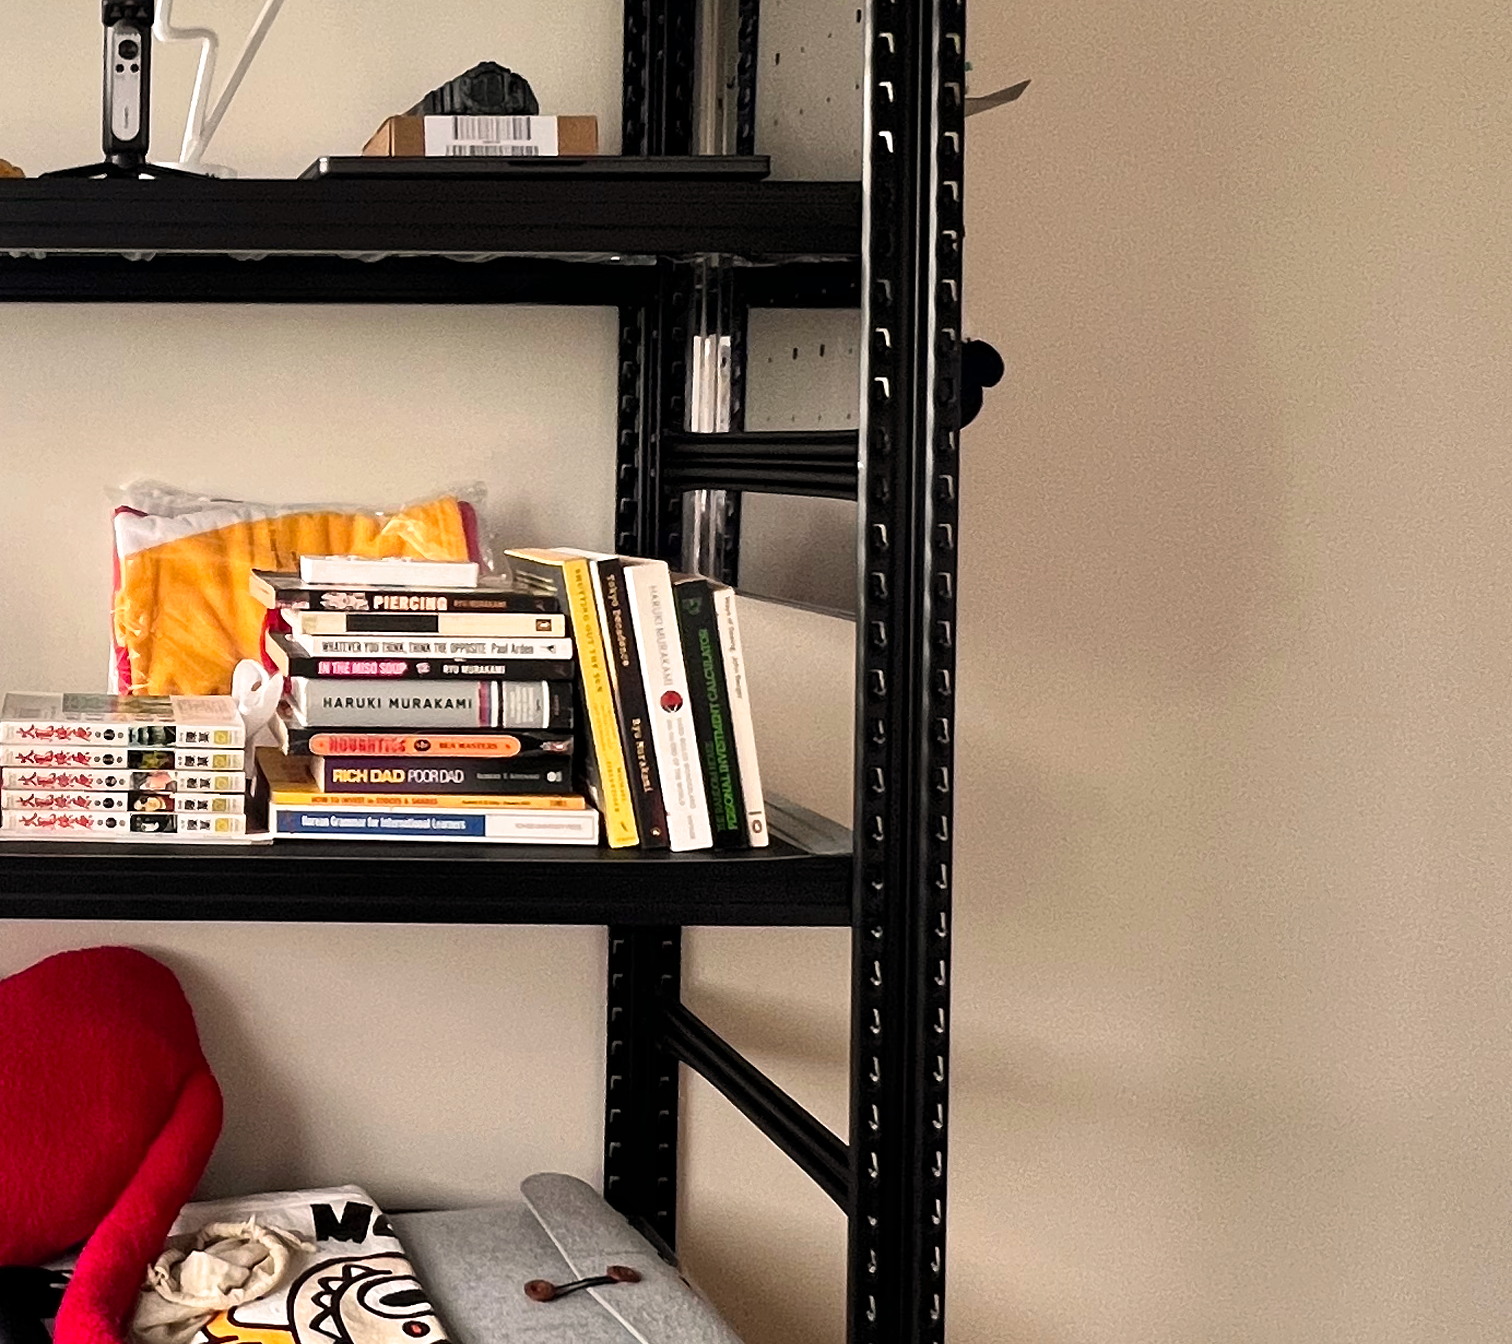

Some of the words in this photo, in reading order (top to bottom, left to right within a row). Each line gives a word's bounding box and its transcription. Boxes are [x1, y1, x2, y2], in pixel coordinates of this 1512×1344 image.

[373, 596, 448, 611] PIERCING
[606, 574, 620, 607] Tokyo
[648, 585, 664, 626] HARUKI
[322, 642, 362, 653] WHATEVER
[364, 642, 380, 653] YOU
[433, 643, 448, 654] THE
[450, 643, 487, 654] OPPOSITE
[491, 643, 508, 654] Paul
[510, 643, 535, 654] Arden
[585, 624, 595, 645] OUT
[612, 608, 630, 667] Decadence
[461, 665, 506, 674] MURAKAMI
[655, 627, 674, 687] MURAKAMI
[698, 628, 719, 702] CALCULATOR
[322, 697, 382, 709] HARUKI
[388, 698, 473, 710] MURAKAMI
[631, 718, 642, 739] Ryu
[709, 703, 730, 773] INVESTMENT
[332, 768, 369, 783] RICH
[370, 769, 406, 784] DAD
[407, 769, 439, 784] POOR
[439, 769, 465, 784] DAD
[636, 740, 654, 793] Murakami
